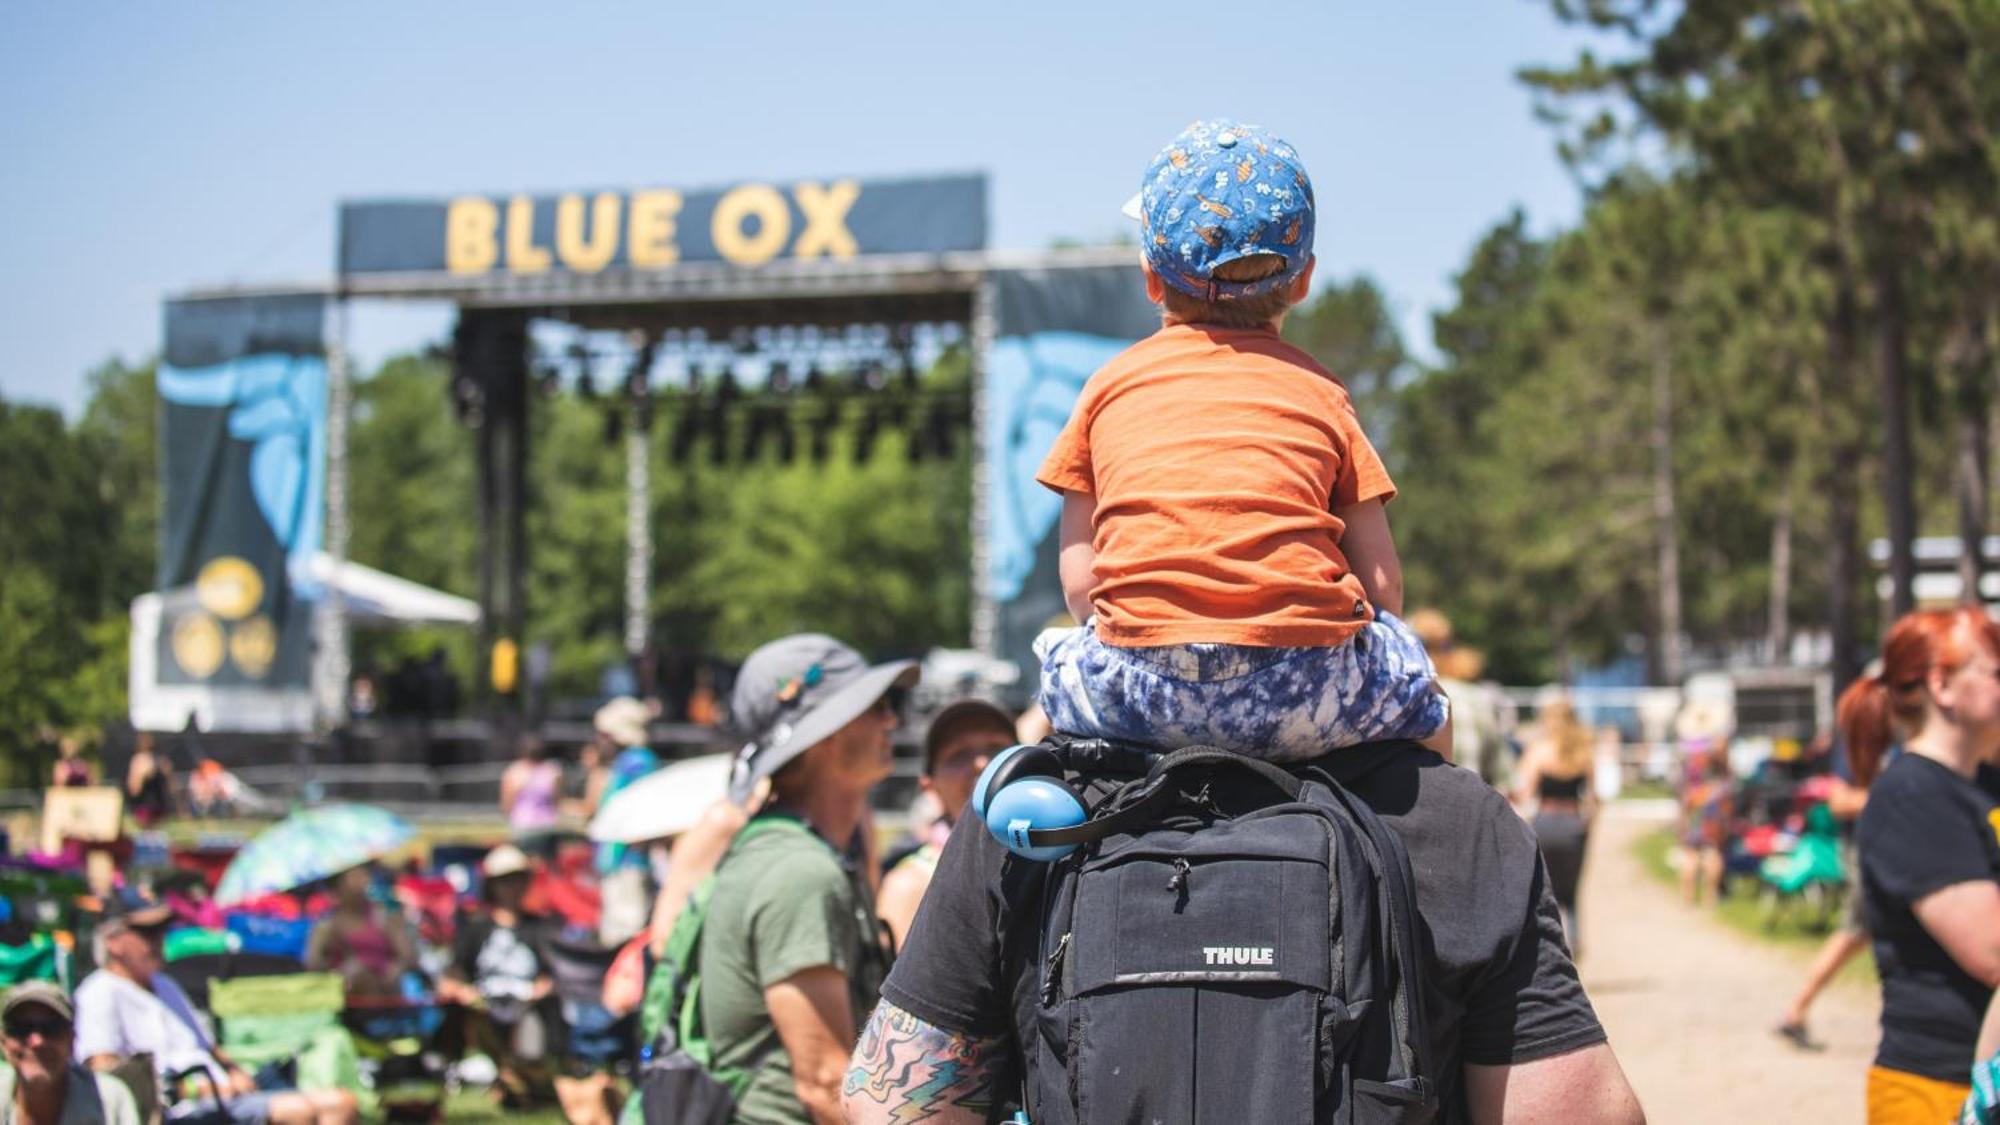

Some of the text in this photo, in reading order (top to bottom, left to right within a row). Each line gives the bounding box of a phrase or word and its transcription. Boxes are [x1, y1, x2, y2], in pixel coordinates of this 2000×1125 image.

[446, 180, 859, 275] BLUE OX
[1203, 947, 1274, 965] THULE
